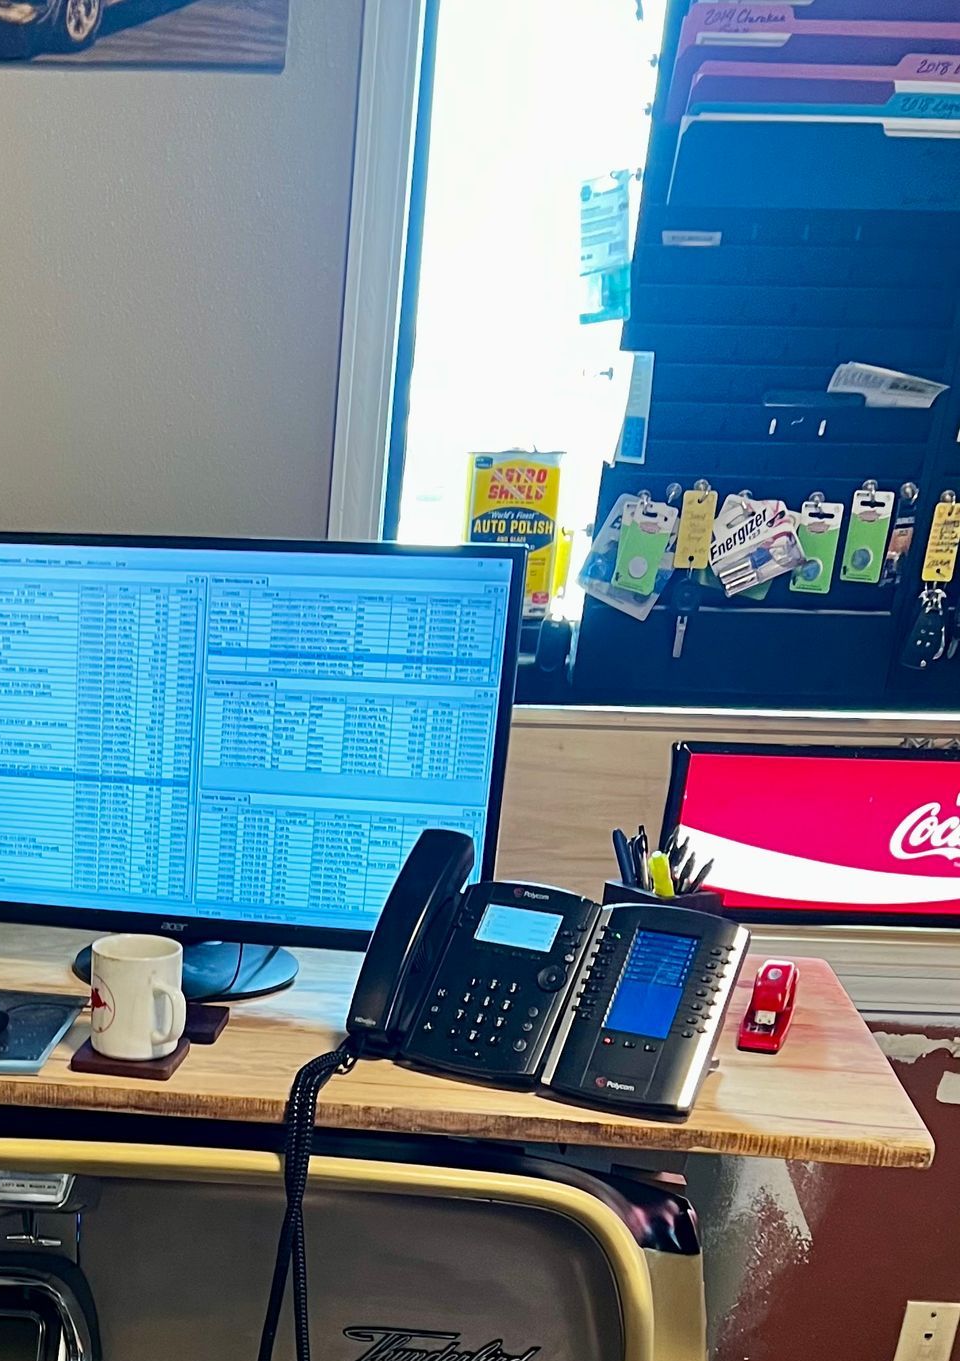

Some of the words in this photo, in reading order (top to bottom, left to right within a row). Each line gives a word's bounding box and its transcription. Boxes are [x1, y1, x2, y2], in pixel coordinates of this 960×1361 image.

[491, 468, 548, 484] ASTRO
[488, 484, 546, 500] SHIELD
[473, 519, 506, 534] AUTO
[510, 519, 553, 535] POLISH
[710, 507, 768, 561] Energizer
[523, 890, 550, 901] Polycom
[160, 921, 189, 932] acer
[606, 1080, 635, 1092] Polycom
